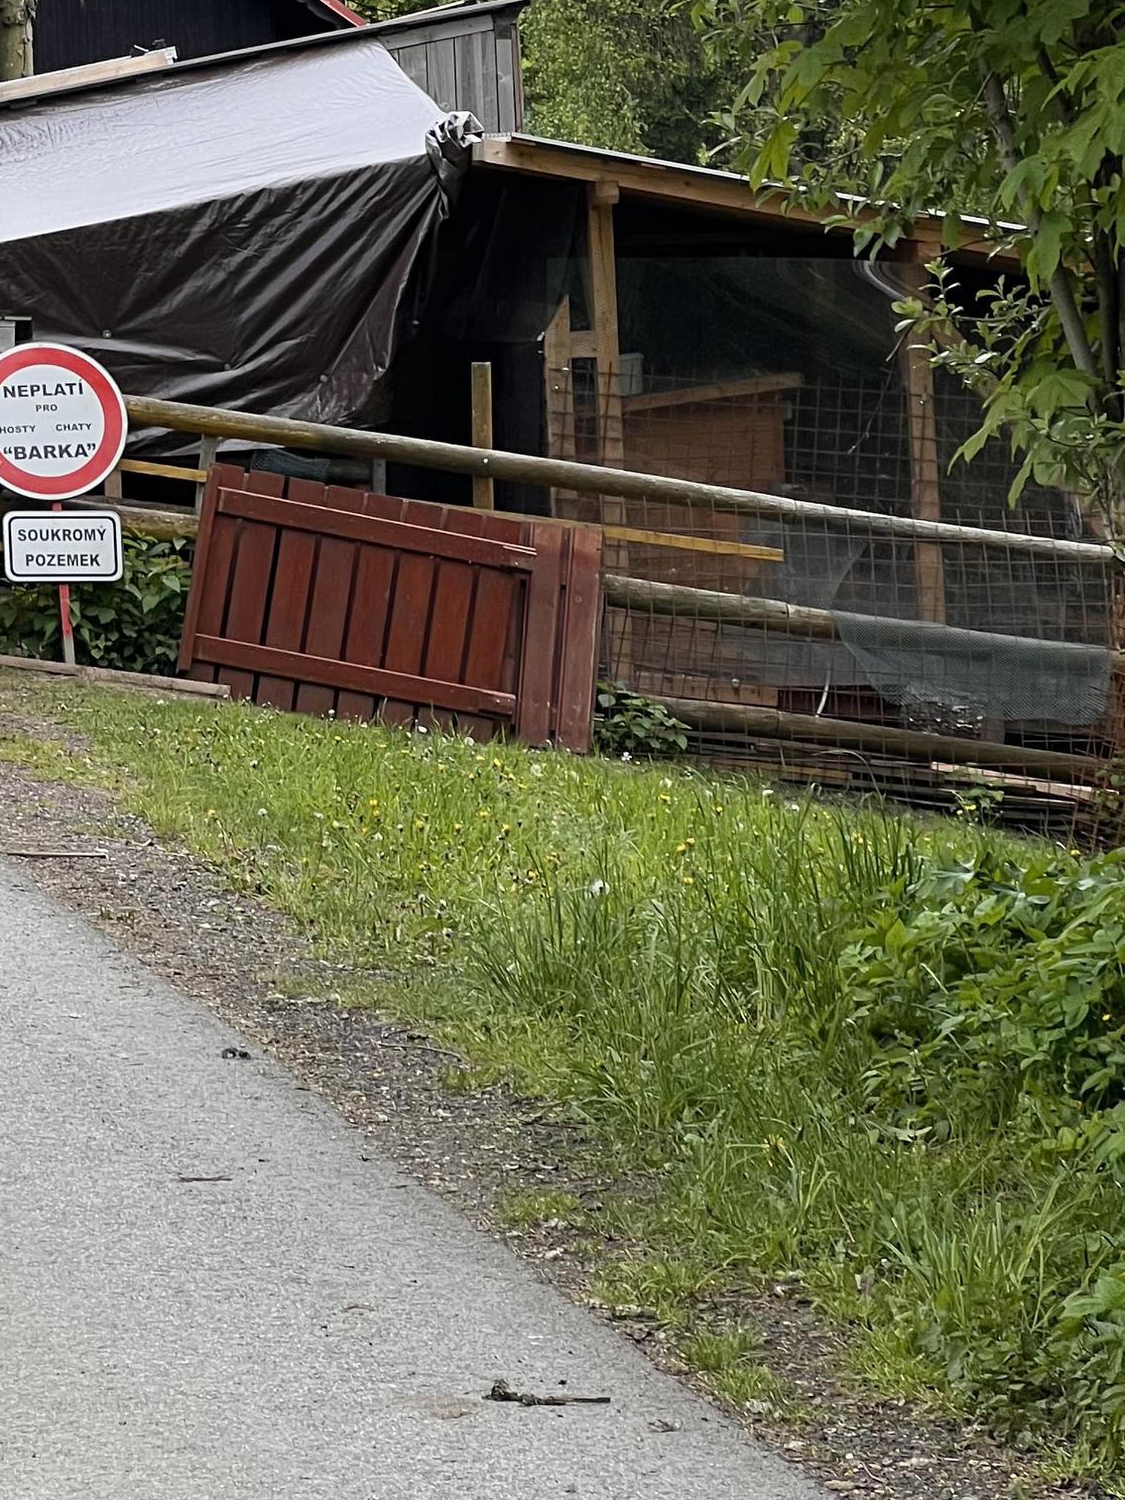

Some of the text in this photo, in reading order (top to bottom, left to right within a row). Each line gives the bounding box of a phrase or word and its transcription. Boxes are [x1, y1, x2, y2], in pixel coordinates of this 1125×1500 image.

[2, 379, 84, 398] NEPLATÍ
[35, 404, 58, 412] PRO
[0, 423, 92, 434] HOSTY CHATY
[17, 525, 107, 542] SOUKROMÝ
[25, 554, 101, 567] POZEMEK
